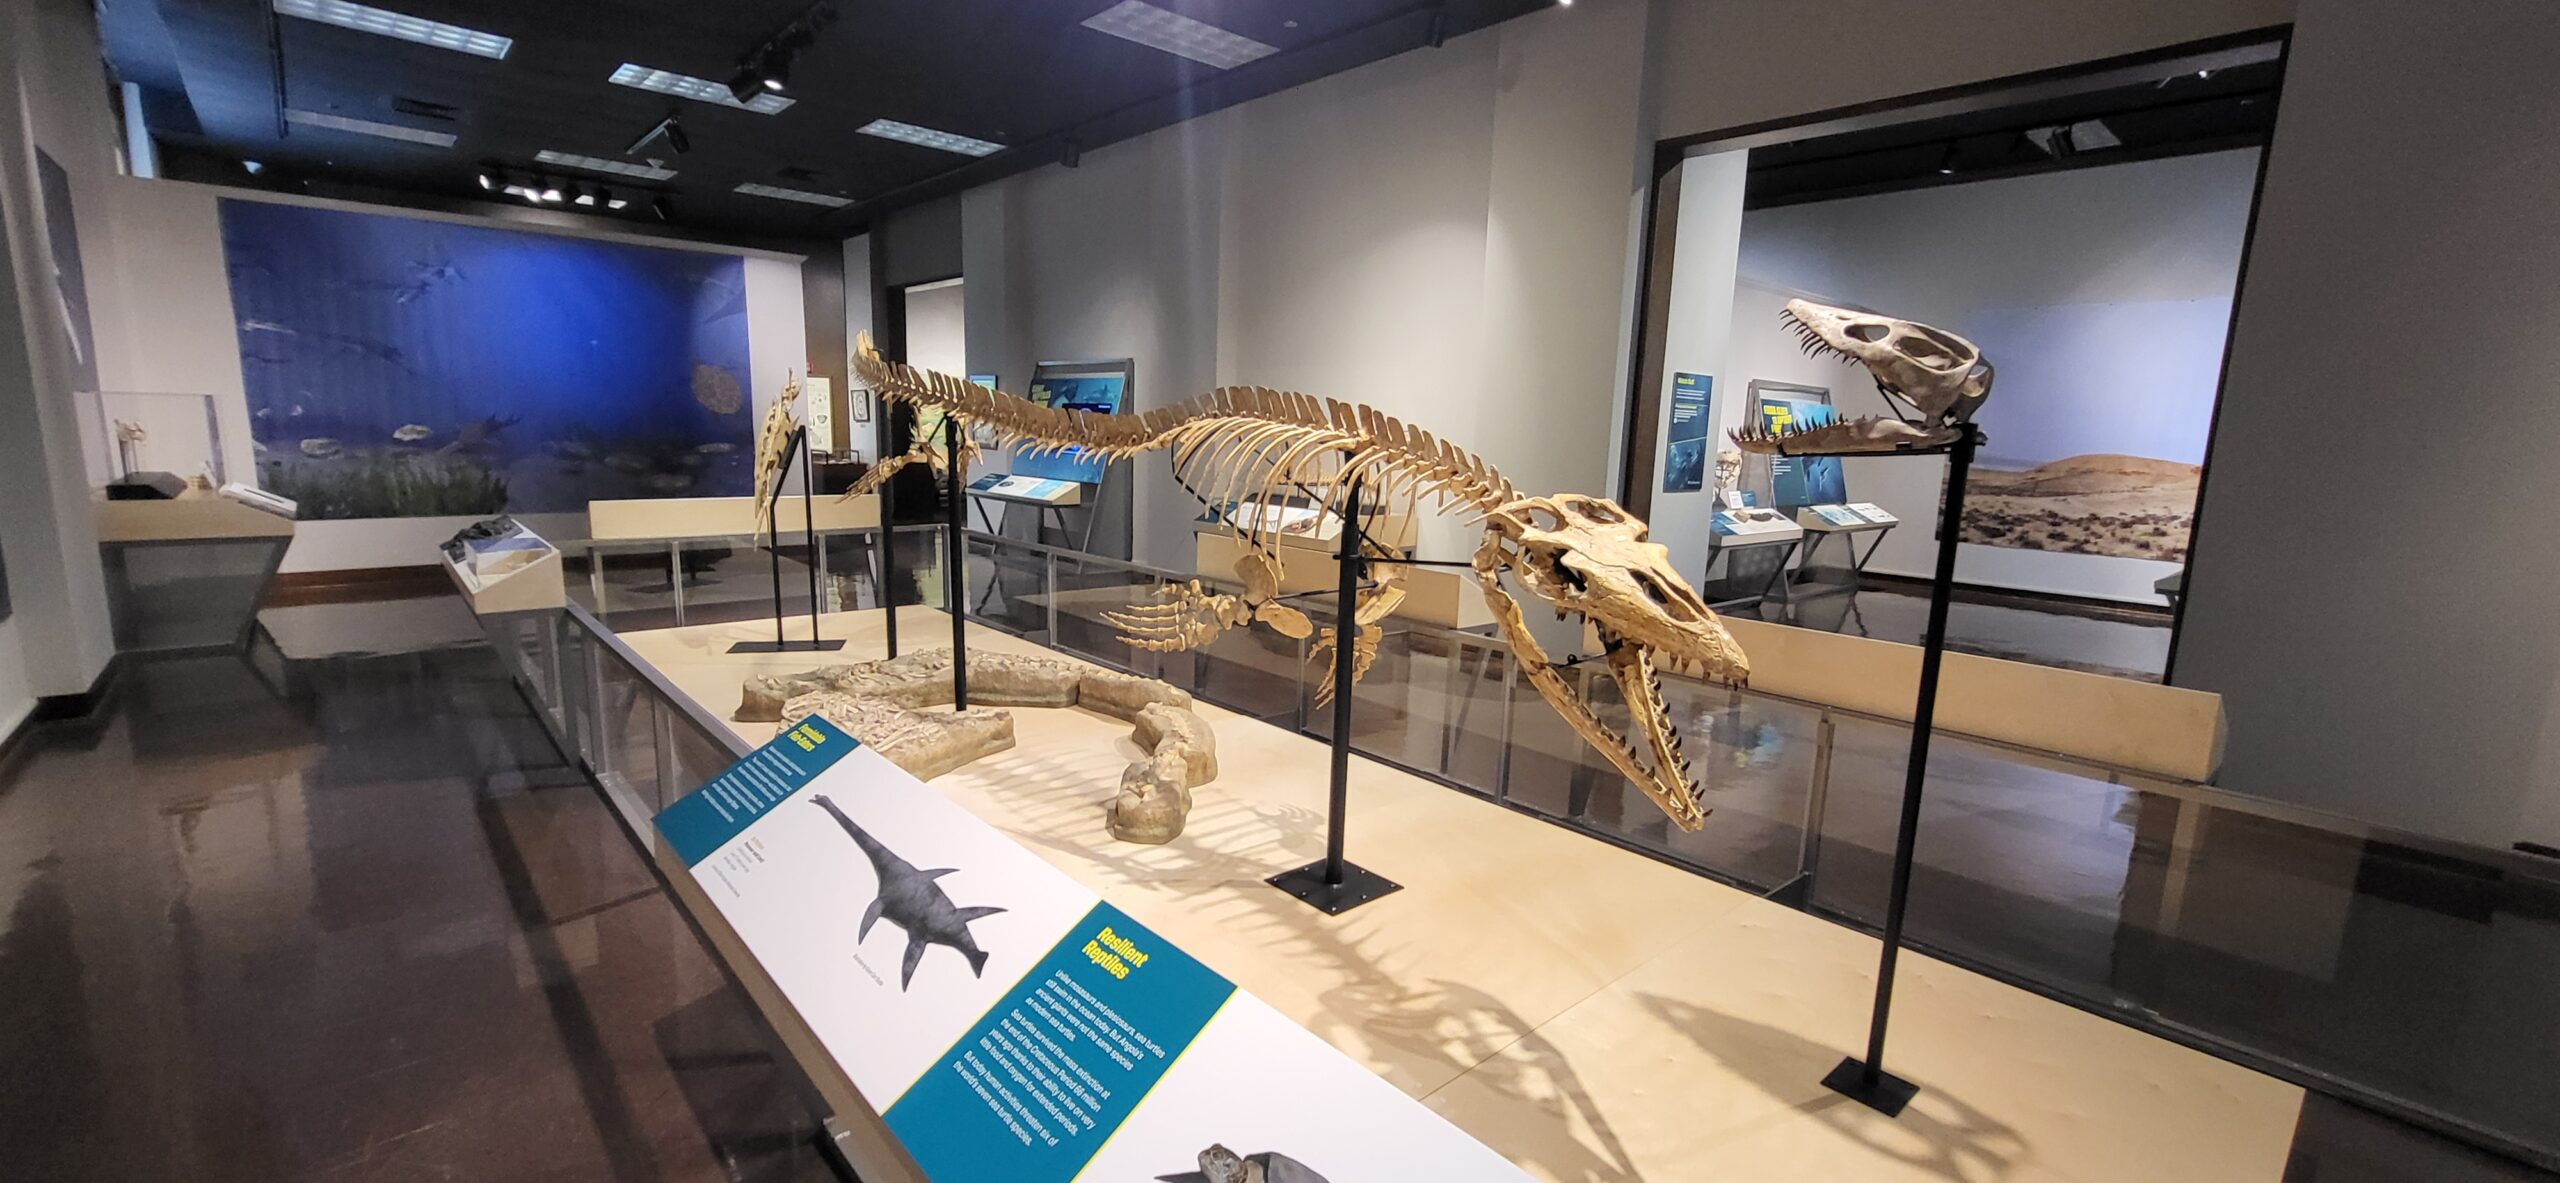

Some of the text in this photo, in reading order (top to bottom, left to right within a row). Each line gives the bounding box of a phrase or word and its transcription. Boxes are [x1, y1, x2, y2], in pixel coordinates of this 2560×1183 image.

[1081, 940, 1130, 979] Reptiles
[1096, 927, 1149, 968] Resilient
[1010, 1008, 1111, 1100] Sea turtles survived the mass extinction at
[1025, 997, 1076, 1041] as modern sea turtles.
[1035, 988, 1133, 1071] ancient giants were not the same species
[1053, 985, 1068, 998] swim
[1065, 994, 1073, 1002] in
[1070, 998, 1081, 1009] the
[1078, 1005, 1096, 1021] ocean
[1093, 1017, 1111, 1034] today.
[1108, 1028, 1122, 1042] But
[1118, 1037, 1144, 1060] Angola's
[1055, 969, 1071, 984] Unlike
[1069, 981, 1096, 1004] mosasaurs
[1093, 1001, 1108, 1012] and
[1134, 1032, 1147, 1044] sea
[1144, 1039, 1165, 1058] turtles
[953, 1060, 1032, 1146] the world's seven sea turtle species.
[963, 1050, 1059, 1146] But today human activities threaten six of
[988, 1028, 1096, 1130] years ago thanks to their ability to live on very
[988, 1046, 1003, 1061] food
[998, 1057, 1012, 1069] and
[1007, 1066, 1028, 1085] oxygen
[1024, 1081, 1035, 1092] for
[1032, 1089, 1059, 1115] extended
[1053, 1111, 1078, 1136] periods.
[1000, 1018, 1101, 1112] the end of the Cretaceous Period 66 million
